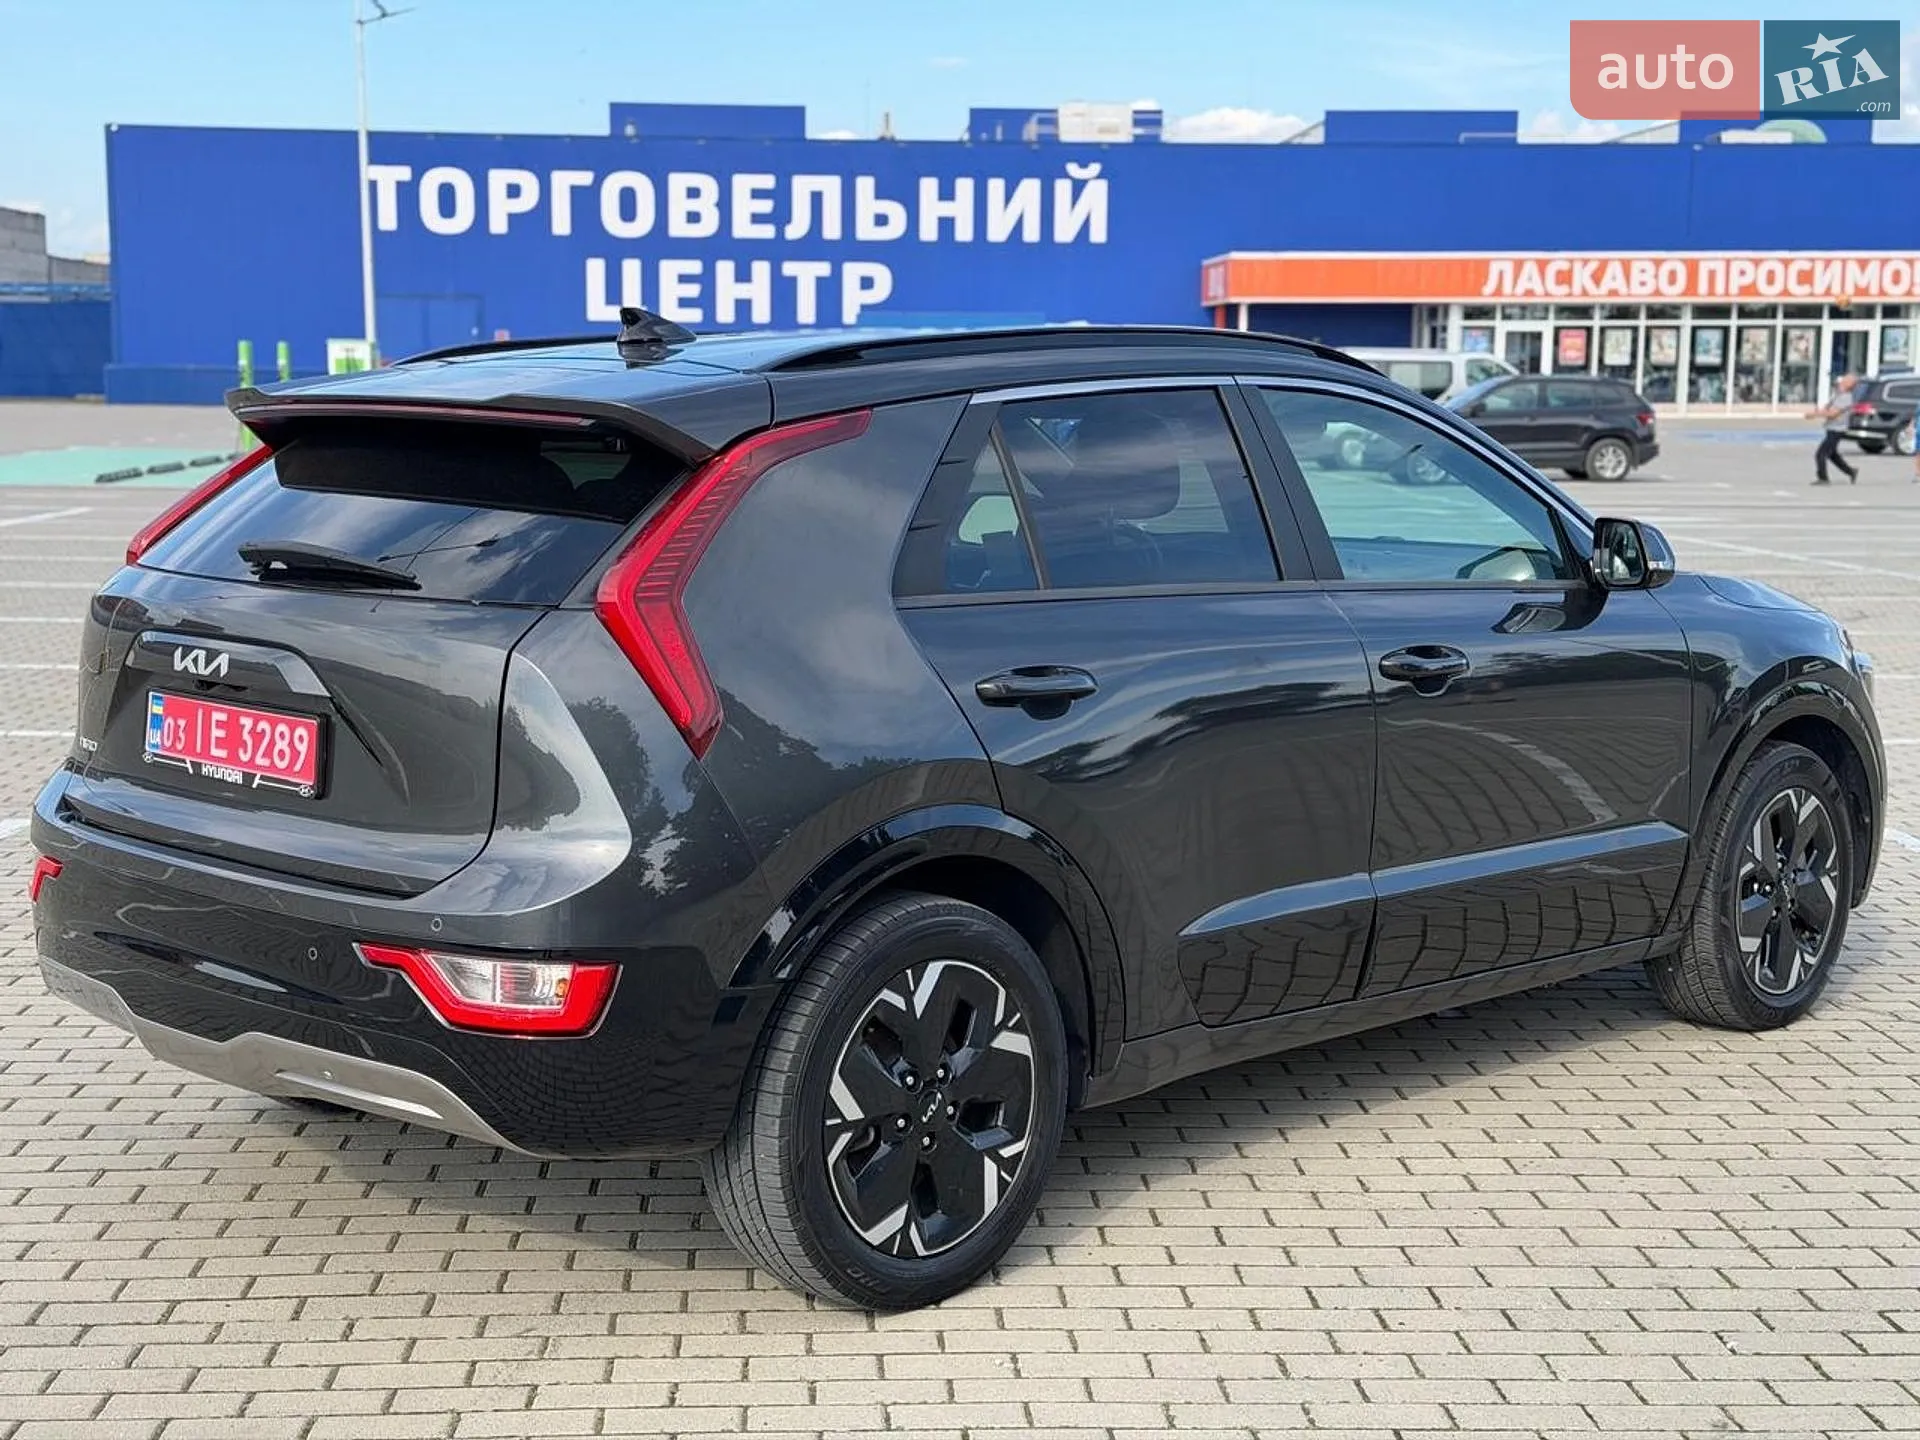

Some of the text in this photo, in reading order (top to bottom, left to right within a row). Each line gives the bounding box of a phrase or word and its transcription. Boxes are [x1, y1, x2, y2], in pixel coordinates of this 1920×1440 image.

[367, 162, 1109, 243] ТОРГОВЕЛЬНИЙ
[585, 257, 893, 325] ЦЕНТР
[1482, 259, 1688, 296] ЛАСКАВО
[173, 646, 229, 678] KIA
[163, 707, 310, 773] 03 IE 3289
[202, 762, 243, 784] HYUNDAI
